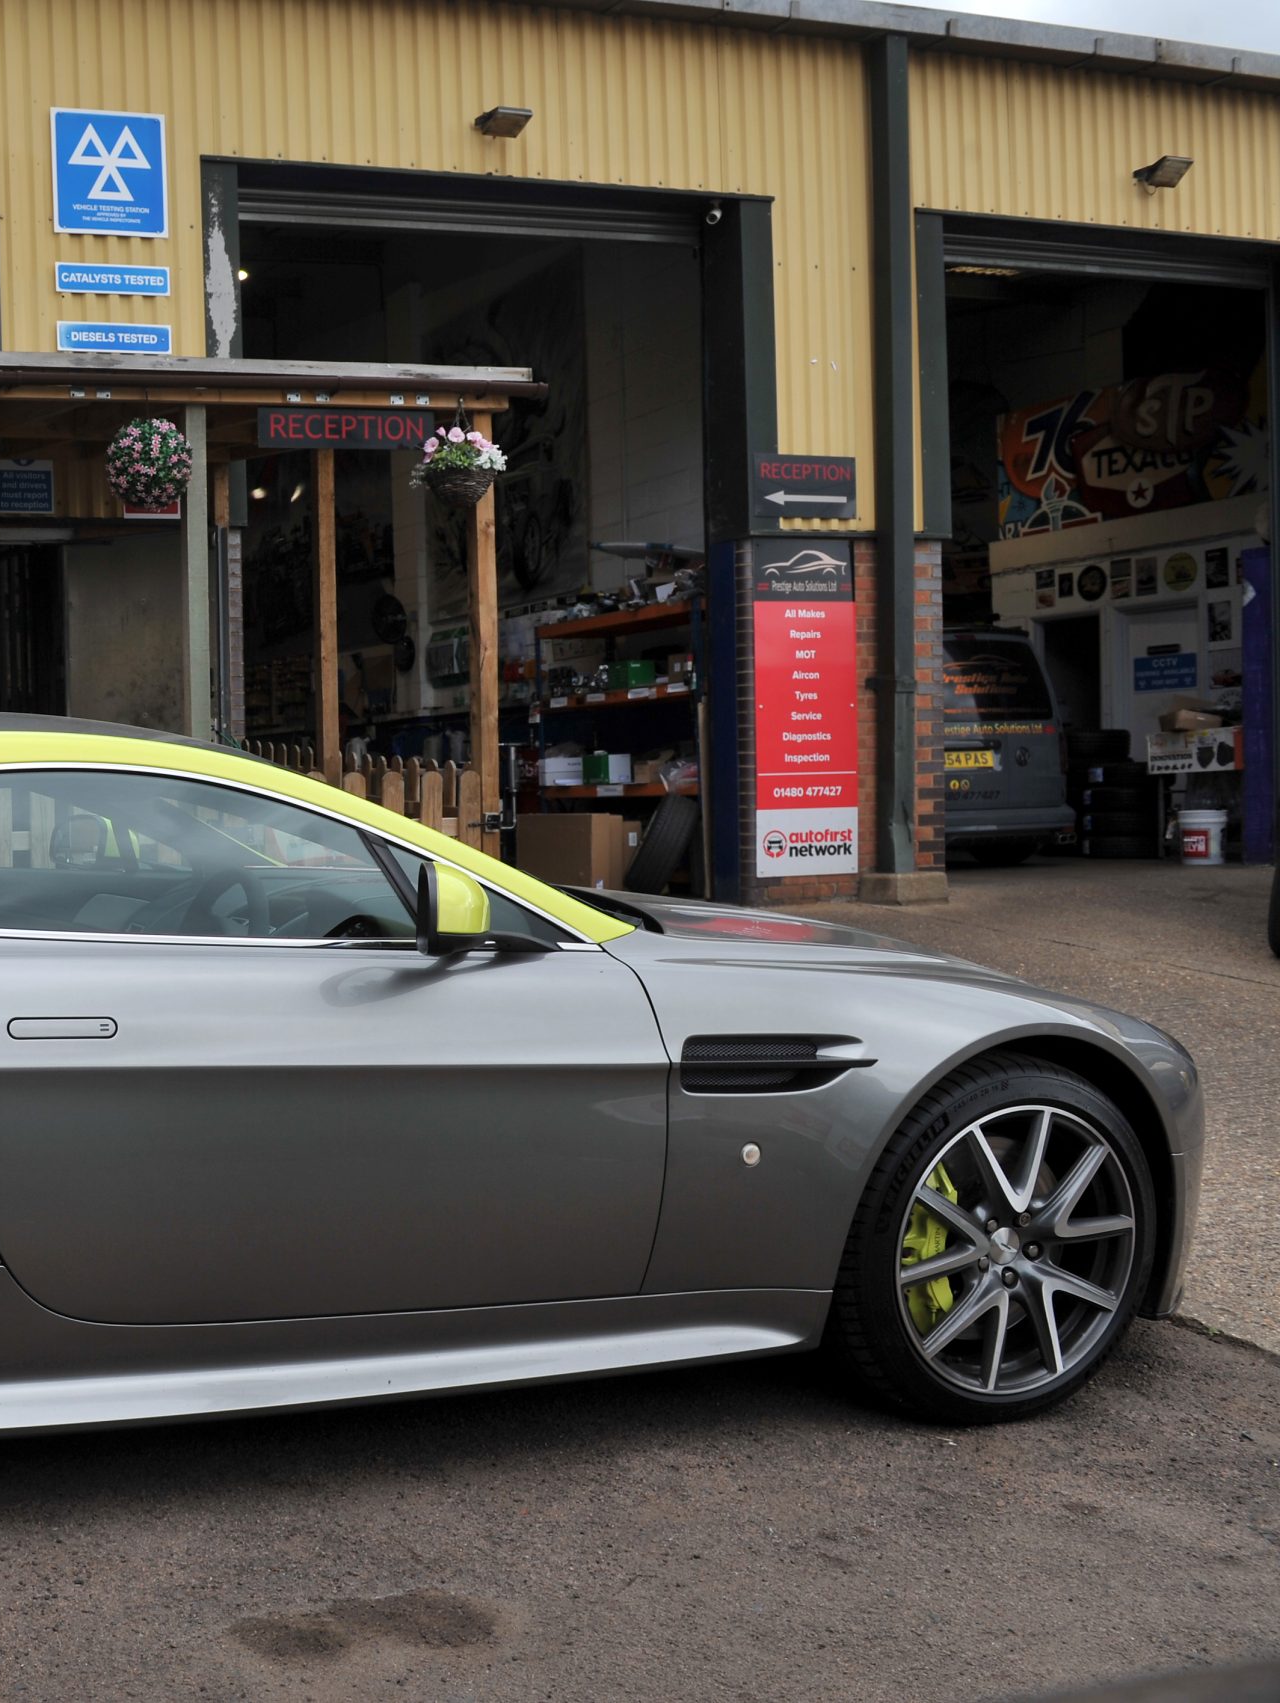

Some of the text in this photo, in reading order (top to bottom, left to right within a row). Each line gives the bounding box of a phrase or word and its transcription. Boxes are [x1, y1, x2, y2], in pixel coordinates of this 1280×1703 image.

[72, 203, 150, 214] VEHICLE TESTING STATION
[61, 272, 164, 286] CATALYSTS TESTED
[71, 331, 157, 344] DIESELS TESTED
[1135, 374, 1214, 447] STP
[269, 413, 423, 441] RECEPTION
[1021, 389, 1102, 482] 76
[761, 463, 853, 481] RECEPTION
[19, 481, 47, 489] drivers
[10, 500, 49, 510] reception
[771, 580, 837, 594] Prestige Auto Solutions Ltd
[784, 609, 825, 618] All Makes
[790, 629, 821, 640] Repairs
[795, 650, 816, 659] MOT
[1151, 658, 1178, 668] CCTV
[792, 670, 820, 679] Aircon
[795, 690, 818, 702] Tyres
[791, 711, 822, 721] Service
[944, 723, 1042, 736] estige Auto Solutions Ltd
[782, 732, 832, 743] Diagnostics
[784, 753, 830, 764] Inspection
[964, 753, 988, 765] PAS
[773, 786, 842, 798] 01480 477427
[789, 828, 852, 843] autofirst
[789, 842, 852, 857] network
[884, 1114, 948, 1209] MICHELIN
